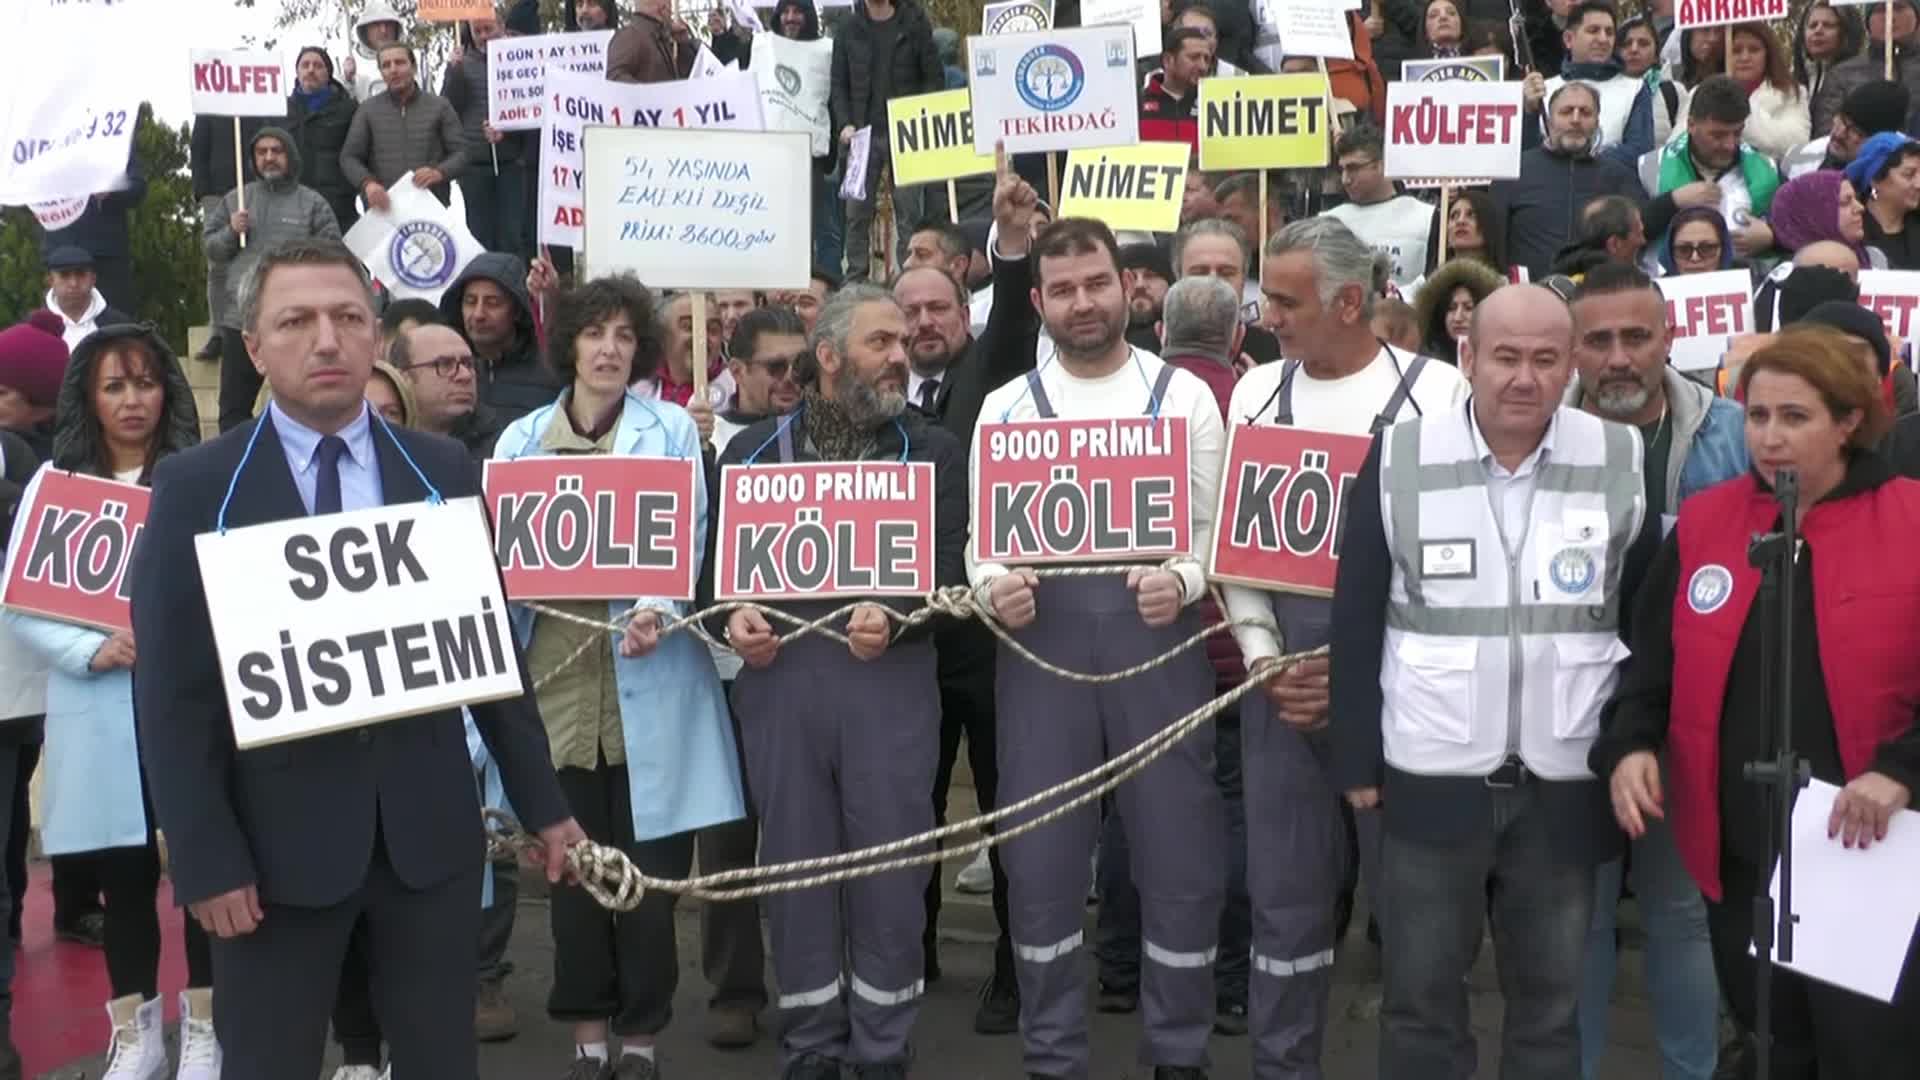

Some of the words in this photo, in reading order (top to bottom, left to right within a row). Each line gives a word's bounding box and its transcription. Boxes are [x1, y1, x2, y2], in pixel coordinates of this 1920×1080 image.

[507, 48, 533, 62] GÜN
[549, 46, 565, 58] AY
[581, 43, 600, 55] YIL
[193, 58, 281, 94] KÜLFET
[496, 68, 513, 81] İŞE
[517, 66, 538, 80] GEÇ
[511, 86, 526, 99] YIL
[102, 110, 127, 137] 32
[499, 106, 528, 121] ADİL
[565, 96, 604, 123] GÜN
[611, 106, 621, 127] 1
[633, 109, 663, 127] AY
[673, 106, 685, 127] 1
[695, 100, 736, 125] YIL
[897, 107, 974, 154] NİME
[1001, 106, 1117, 138] TEKİRDAĞ
[1206, 90, 1324, 138] NİMET
[1391, 96, 1518, 145] KÜLFET
[552, 124, 576, 153] İŞE
[552, 164, 569, 188] 17
[668, 157, 751, 182] YAŞINDA
[1069, 156, 1183, 201] NİMET
[554, 205, 584, 227] AD
[1665, 292, 1749, 339] LFET
[989, 428, 1060, 463] 9000
[1069, 416, 1173, 459] PRİMLİ
[735, 471, 806, 505] 8000
[814, 463, 917, 504] PRİMLİ
[498, 474, 680, 570] KÖLE
[990, 464, 1177, 559] KÖLE
[284, 518, 429, 602] SGK
[733, 508, 920, 595] KÖLE
[237, 595, 507, 722] SİSTEMİ
